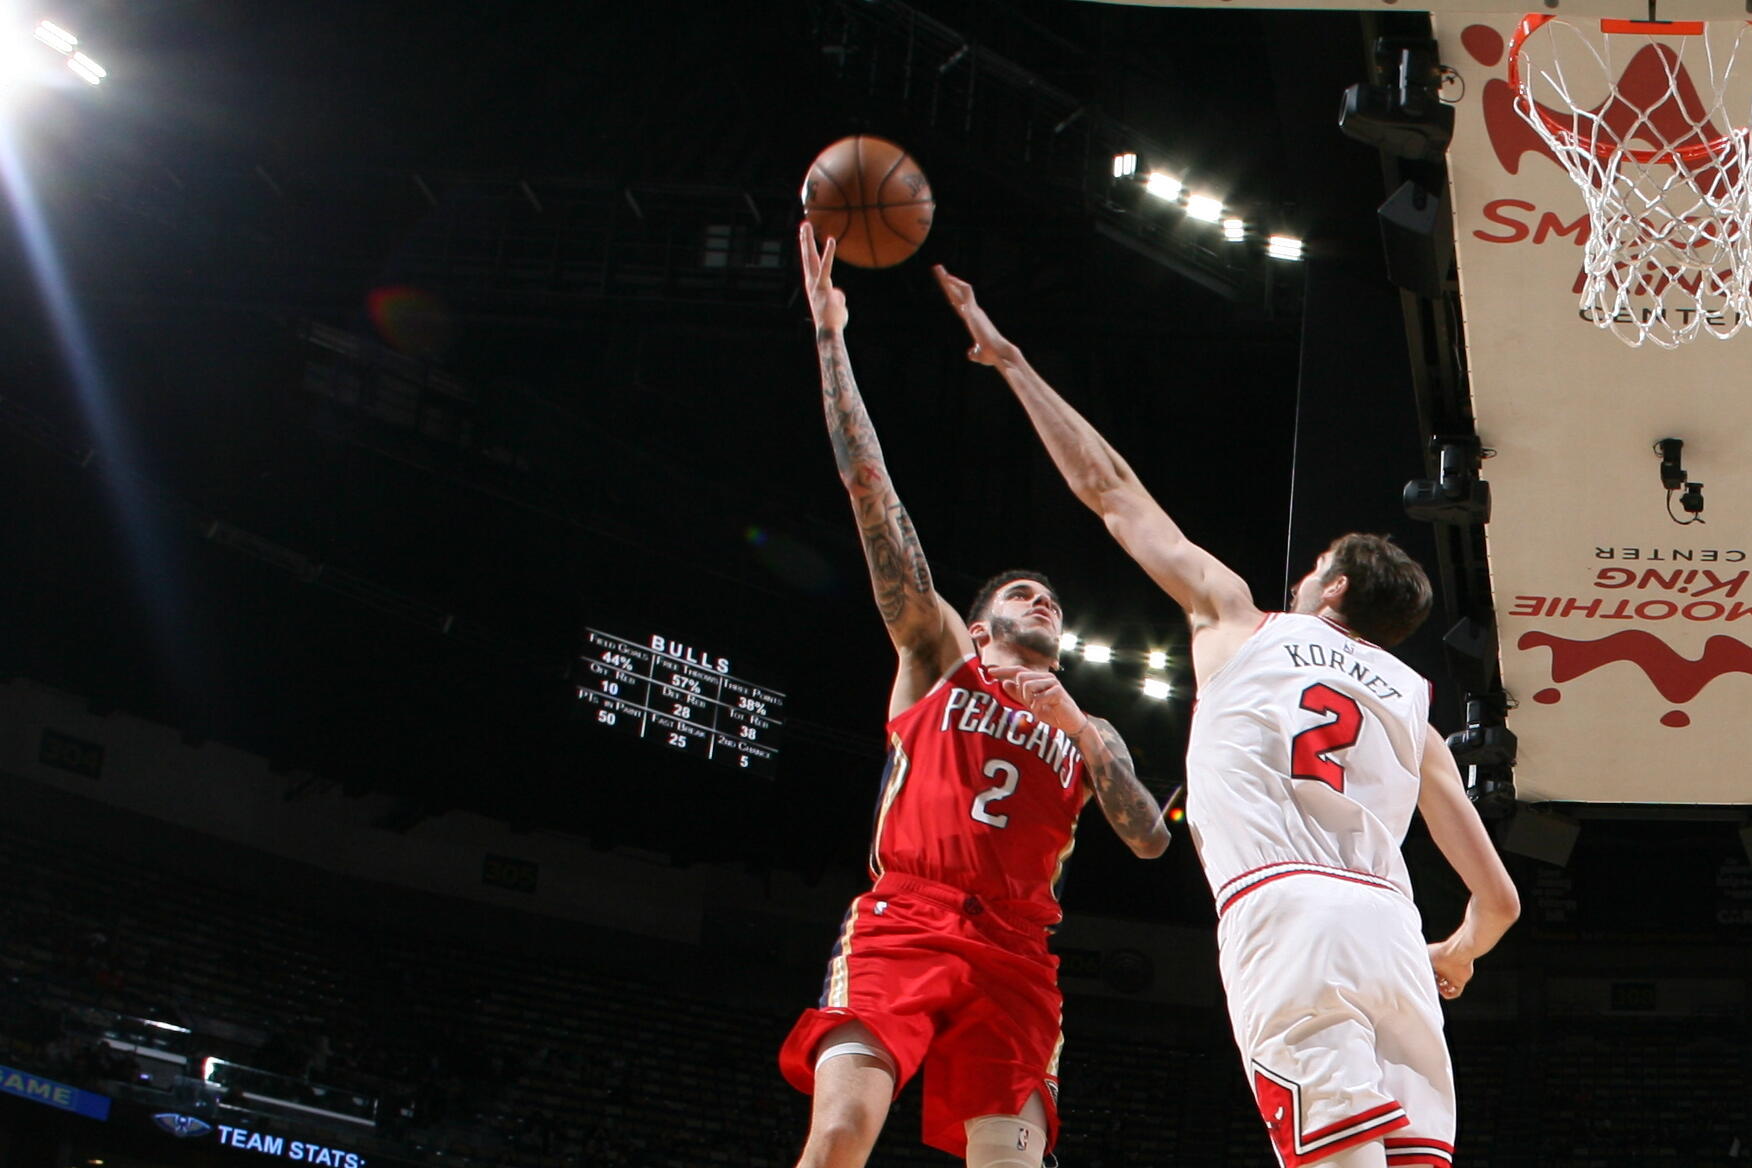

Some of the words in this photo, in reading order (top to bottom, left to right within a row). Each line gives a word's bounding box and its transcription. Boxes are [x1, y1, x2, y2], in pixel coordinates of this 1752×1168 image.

[1594, 547, 1747, 563] CENTER
[601, 650, 634, 671] 44%
[651, 634, 730, 674] BULLS
[1284, 643, 1403, 702] KORNET
[601, 679, 619, 696] 10
[671, 673, 701, 694] 57%
[672, 704, 691, 719] 28
[738, 696, 767, 716] 38%
[597, 710, 617, 726] 50
[668, 732, 687, 749] 25
[738, 724, 757, 741] 38
[941, 686, 1084, 790] PELICANS
[1290, 681, 1364, 795] 2
[739, 755, 750, 769] 5
[970, 757, 1020, 830] 2
[216, 1123, 285, 1157] TEAM
